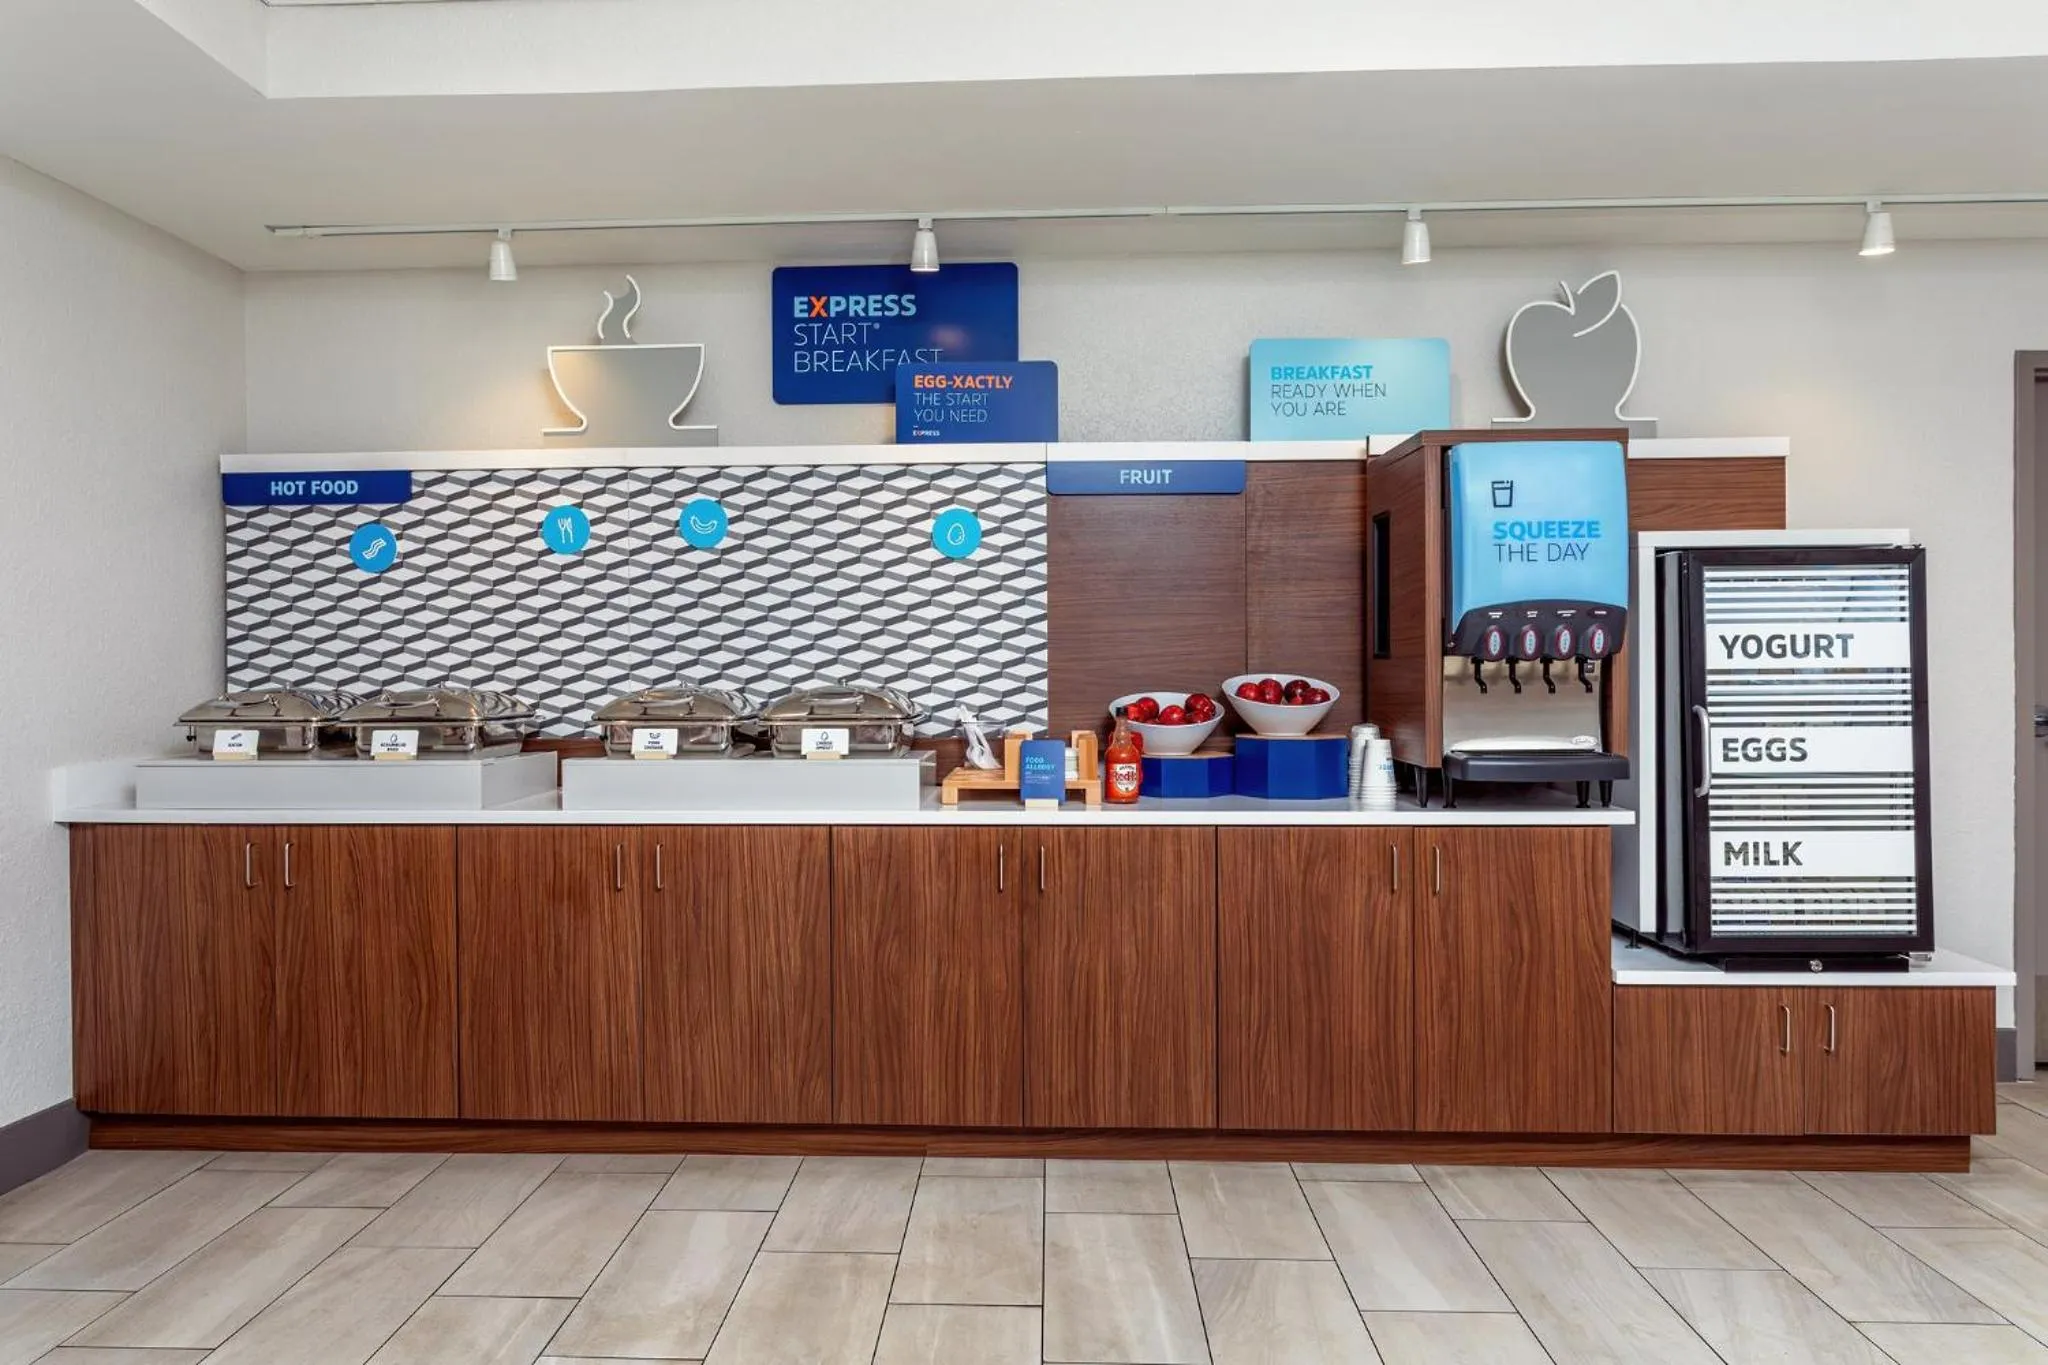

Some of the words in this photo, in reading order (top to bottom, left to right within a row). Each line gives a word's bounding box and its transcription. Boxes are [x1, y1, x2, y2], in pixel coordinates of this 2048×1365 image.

[794, 294, 917, 318] EXPRESS
[1270, 365, 1373, 381] BREAKFAST
[913, 375, 1013, 389] EGG-XACTLY
[1271, 383, 1327, 399] READY
[1333, 382, 1387, 398] WHEN
[914, 392, 941, 406] THE
[946, 392, 989, 406] START
[914, 409, 944, 422] YOU
[949, 409, 988, 422] NEED
[1271, 402, 1307, 417] YOU
[1312, 401, 1347, 416] ARE
[1120, 469, 1173, 485] FRUIT
[270, 480, 306, 497] HOT
[311, 479, 358, 496] FOOD
[1492, 520, 1602, 540] SQUEEZE
[1493, 543, 1538, 563] THE
[1547, 542, 1590, 562] DAY
[1719, 633, 1854, 660] YOGURT
[1722, 737, 1808, 763] EGGS
[1723, 841, 1804, 866] MILK
